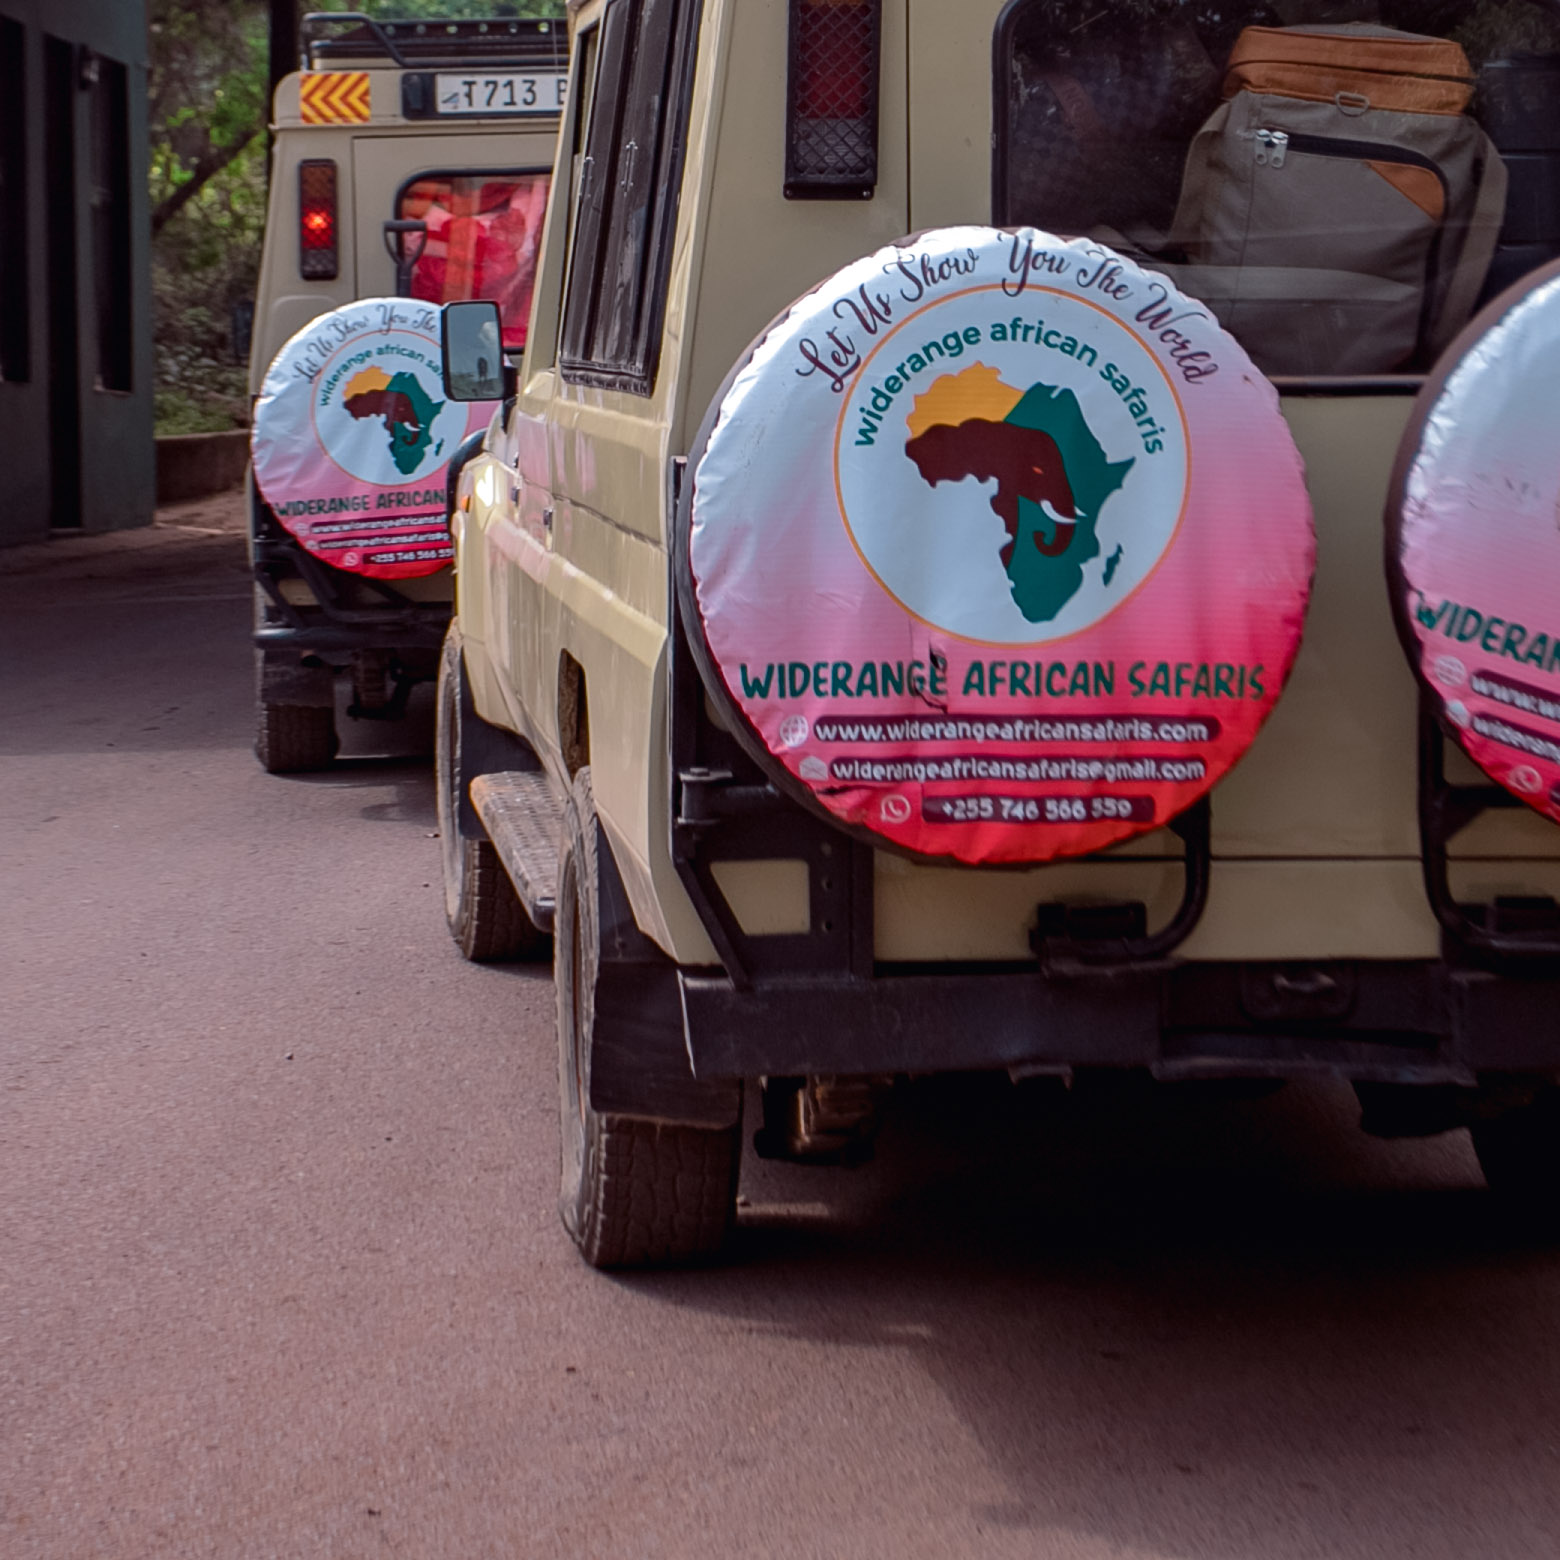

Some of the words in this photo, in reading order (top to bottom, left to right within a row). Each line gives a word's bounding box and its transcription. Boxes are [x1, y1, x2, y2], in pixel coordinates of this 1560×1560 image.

[795, 326, 862, 393] Let
[832, 282, 893, 335] Us
[882, 247, 980, 302] Show
[997, 232, 1072, 298] You
[1076, 249, 1134, 301] The
[1135, 282, 1219, 386] World
[320, 349, 373, 407] widerange
[376, 344, 425, 363] african
[854, 326, 982, 447] widerange
[989, 316, 1099, 368] african
[1098, 361, 1167, 455] safaris
[274, 495, 371, 517] WIDERANGE
[375, 489, 447, 510] AFRICAN
[739, 658, 948, 700] WIDERANGE
[961, 660, 1116, 698] AFRICAN
[1127, 660, 1266, 701] SAFARIS
[815, 718, 1210, 743] www.widerangeafricansafaris.com
[832, 757, 1206, 784] widerangeafricansafaris@gmail.com
[1000, 797, 1040, 822] 746
